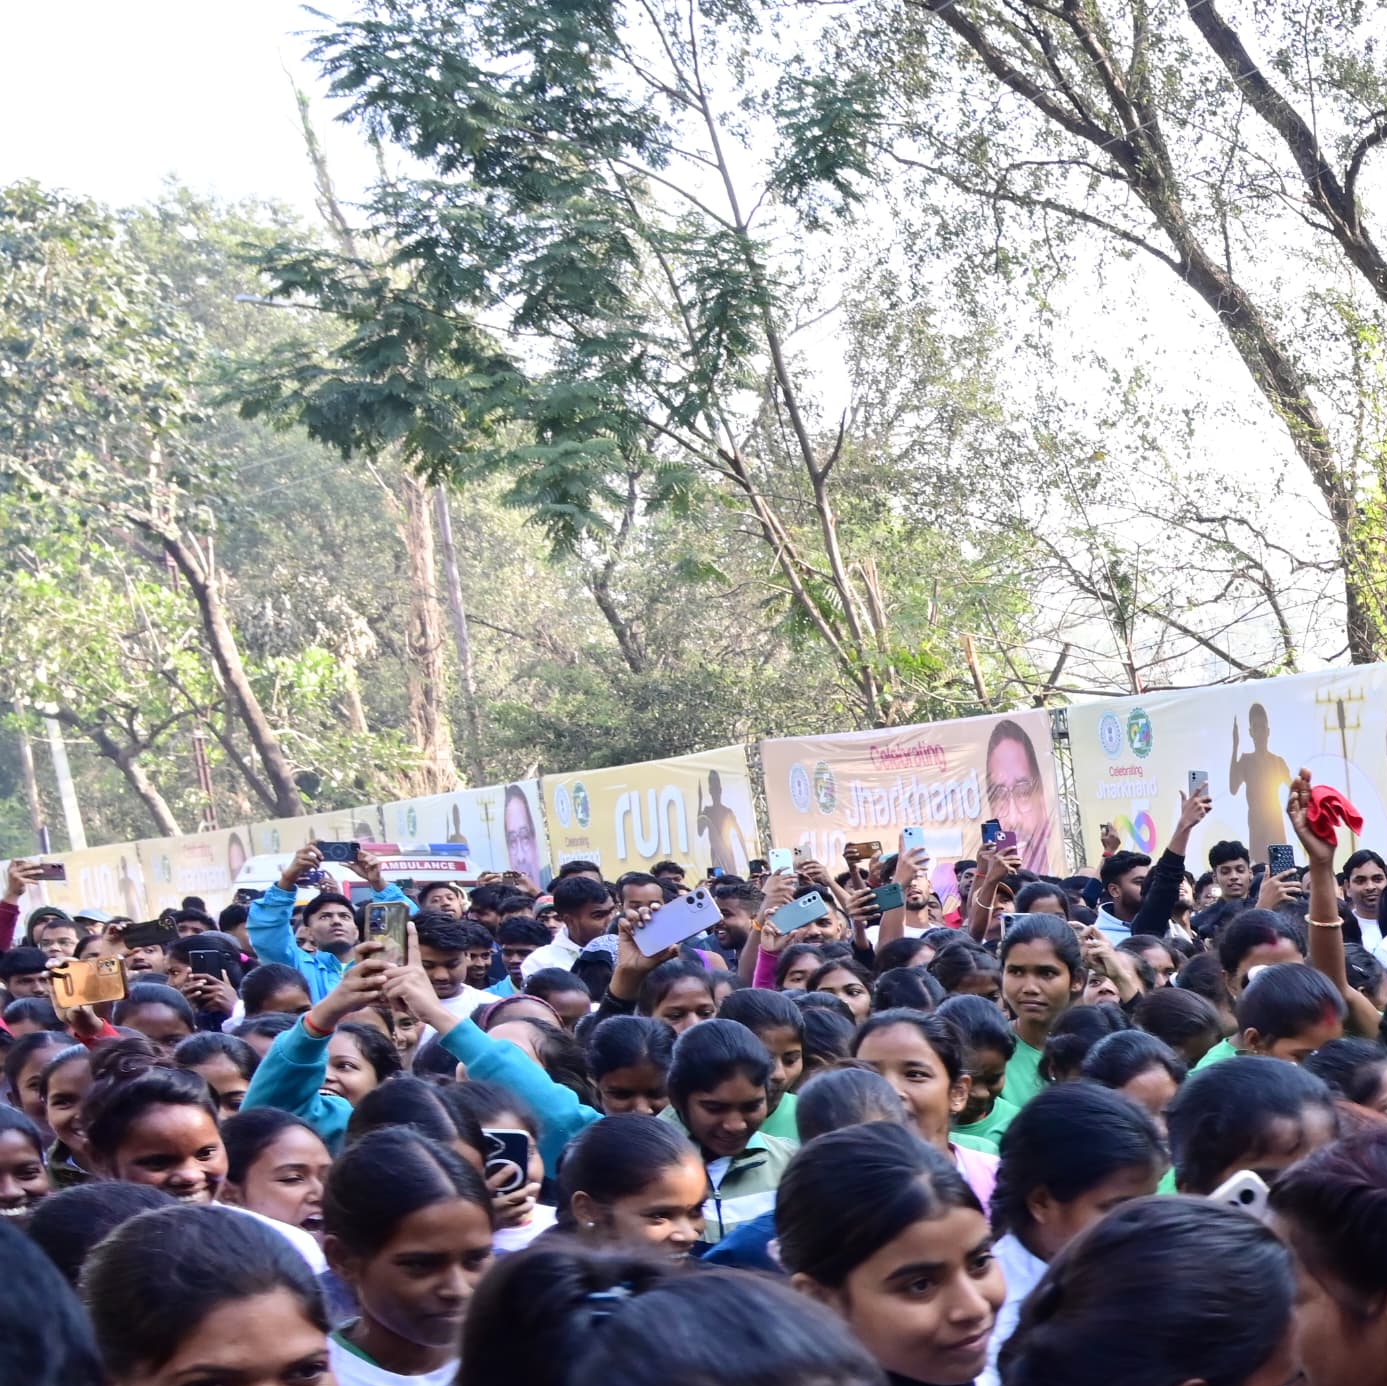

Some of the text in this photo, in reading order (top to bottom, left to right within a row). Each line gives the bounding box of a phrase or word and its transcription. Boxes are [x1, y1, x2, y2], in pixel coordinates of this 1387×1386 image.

[869, 740, 948, 773] Celebrating
[845, 767, 982, 828] Jharkhand
[1096, 775, 1159, 800] Jharkhand
[614, 783, 690, 861] run
[380, 861, 457, 871] AMBULANCE
